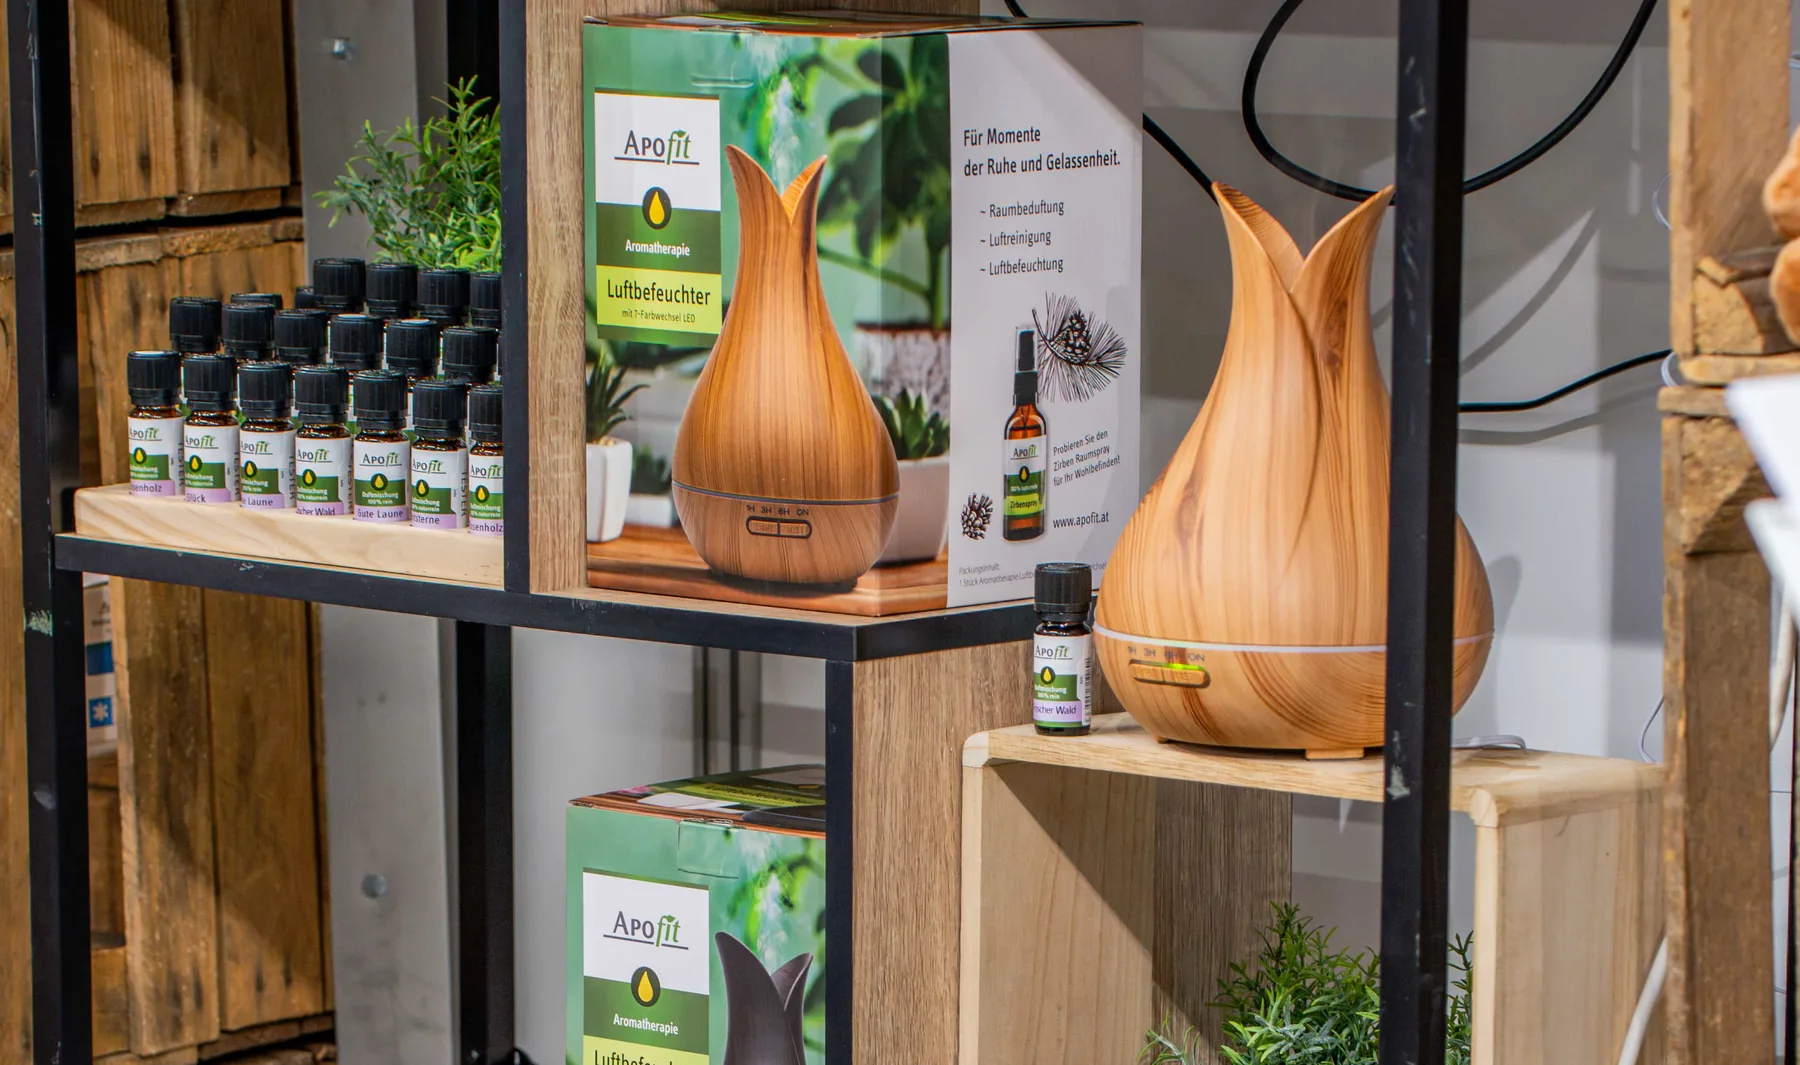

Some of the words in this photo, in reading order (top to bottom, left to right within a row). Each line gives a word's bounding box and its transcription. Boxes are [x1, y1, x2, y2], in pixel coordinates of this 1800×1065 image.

[964, 129, 983, 147] Für
[987, 126, 1041, 145] Momente
[964, 159, 983, 177] der
[987, 156, 1017, 175] Ruhe
[1021, 154, 1042, 173] und
[1046, 148, 1121, 171] Gelassenheit.
[989, 200, 1064, 218] Raumbeduftung
[989, 230, 1052, 247] Luftreinigung
[625, 239, 690, 258] Aromatherapie
[989, 257, 1064, 276] Luftbefeuchtung
[607, 279, 711, 305] Luftbefeuchter
[622, 309, 633, 318] mit
[634, 309, 682, 322] 7-Farbwechsel
[683, 313, 696, 323] LED
[1053, 438, 1083, 456] Probieren
[1085, 434, 1095, 445] Sie
[1096, 430, 1108, 441] den
[1053, 458, 1074, 472] Zirben
[1076, 445, 1110, 464] Raumspray
[1053, 476, 1063, 486] für
[1064, 473, 1074, 483] Ihr
[1074, 454, 1121, 479] Wohlbefinden!
[247, 498, 273, 507] Laune
[315, 507, 336, 516] Wald
[761, 506, 772, 514] 3H
[1010, 500, 1038, 509] Zirbenspray
[357, 508, 374, 518] Gute
[377, 510, 404, 519] Laune
[1052, 511, 1109, 528] www.apofit.at
[1056, 705, 1077, 715] Wald
[613, 1013, 679, 1036] Aromatherapie
